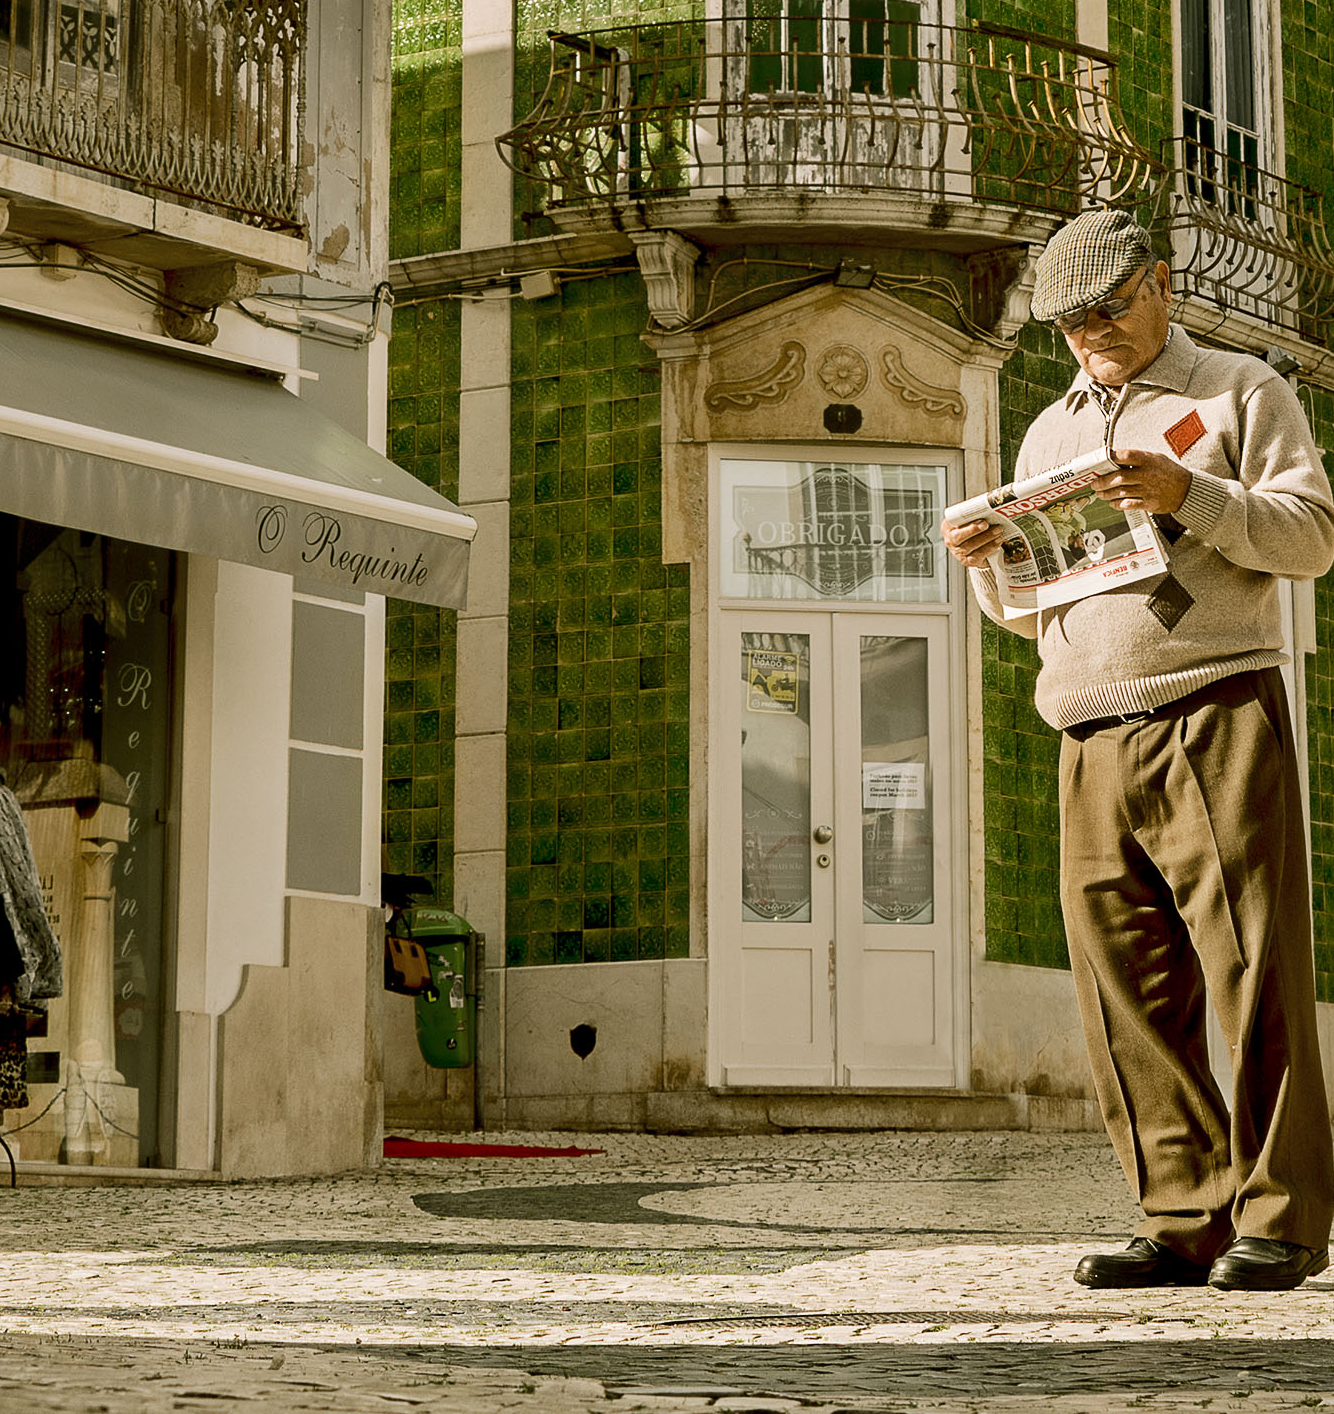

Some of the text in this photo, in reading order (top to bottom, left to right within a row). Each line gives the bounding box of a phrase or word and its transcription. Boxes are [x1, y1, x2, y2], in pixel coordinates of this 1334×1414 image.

[1049, 469, 1075, 485] seduz
[1003, 473, 1098, 517] EDERSON
[757, 520, 910, 548] OBRIGADO
[255, 505, 429, 587] O Requinte
[1103, 564, 1129, 578] BENFICA
[752, 659, 783, 668] LIGADO
